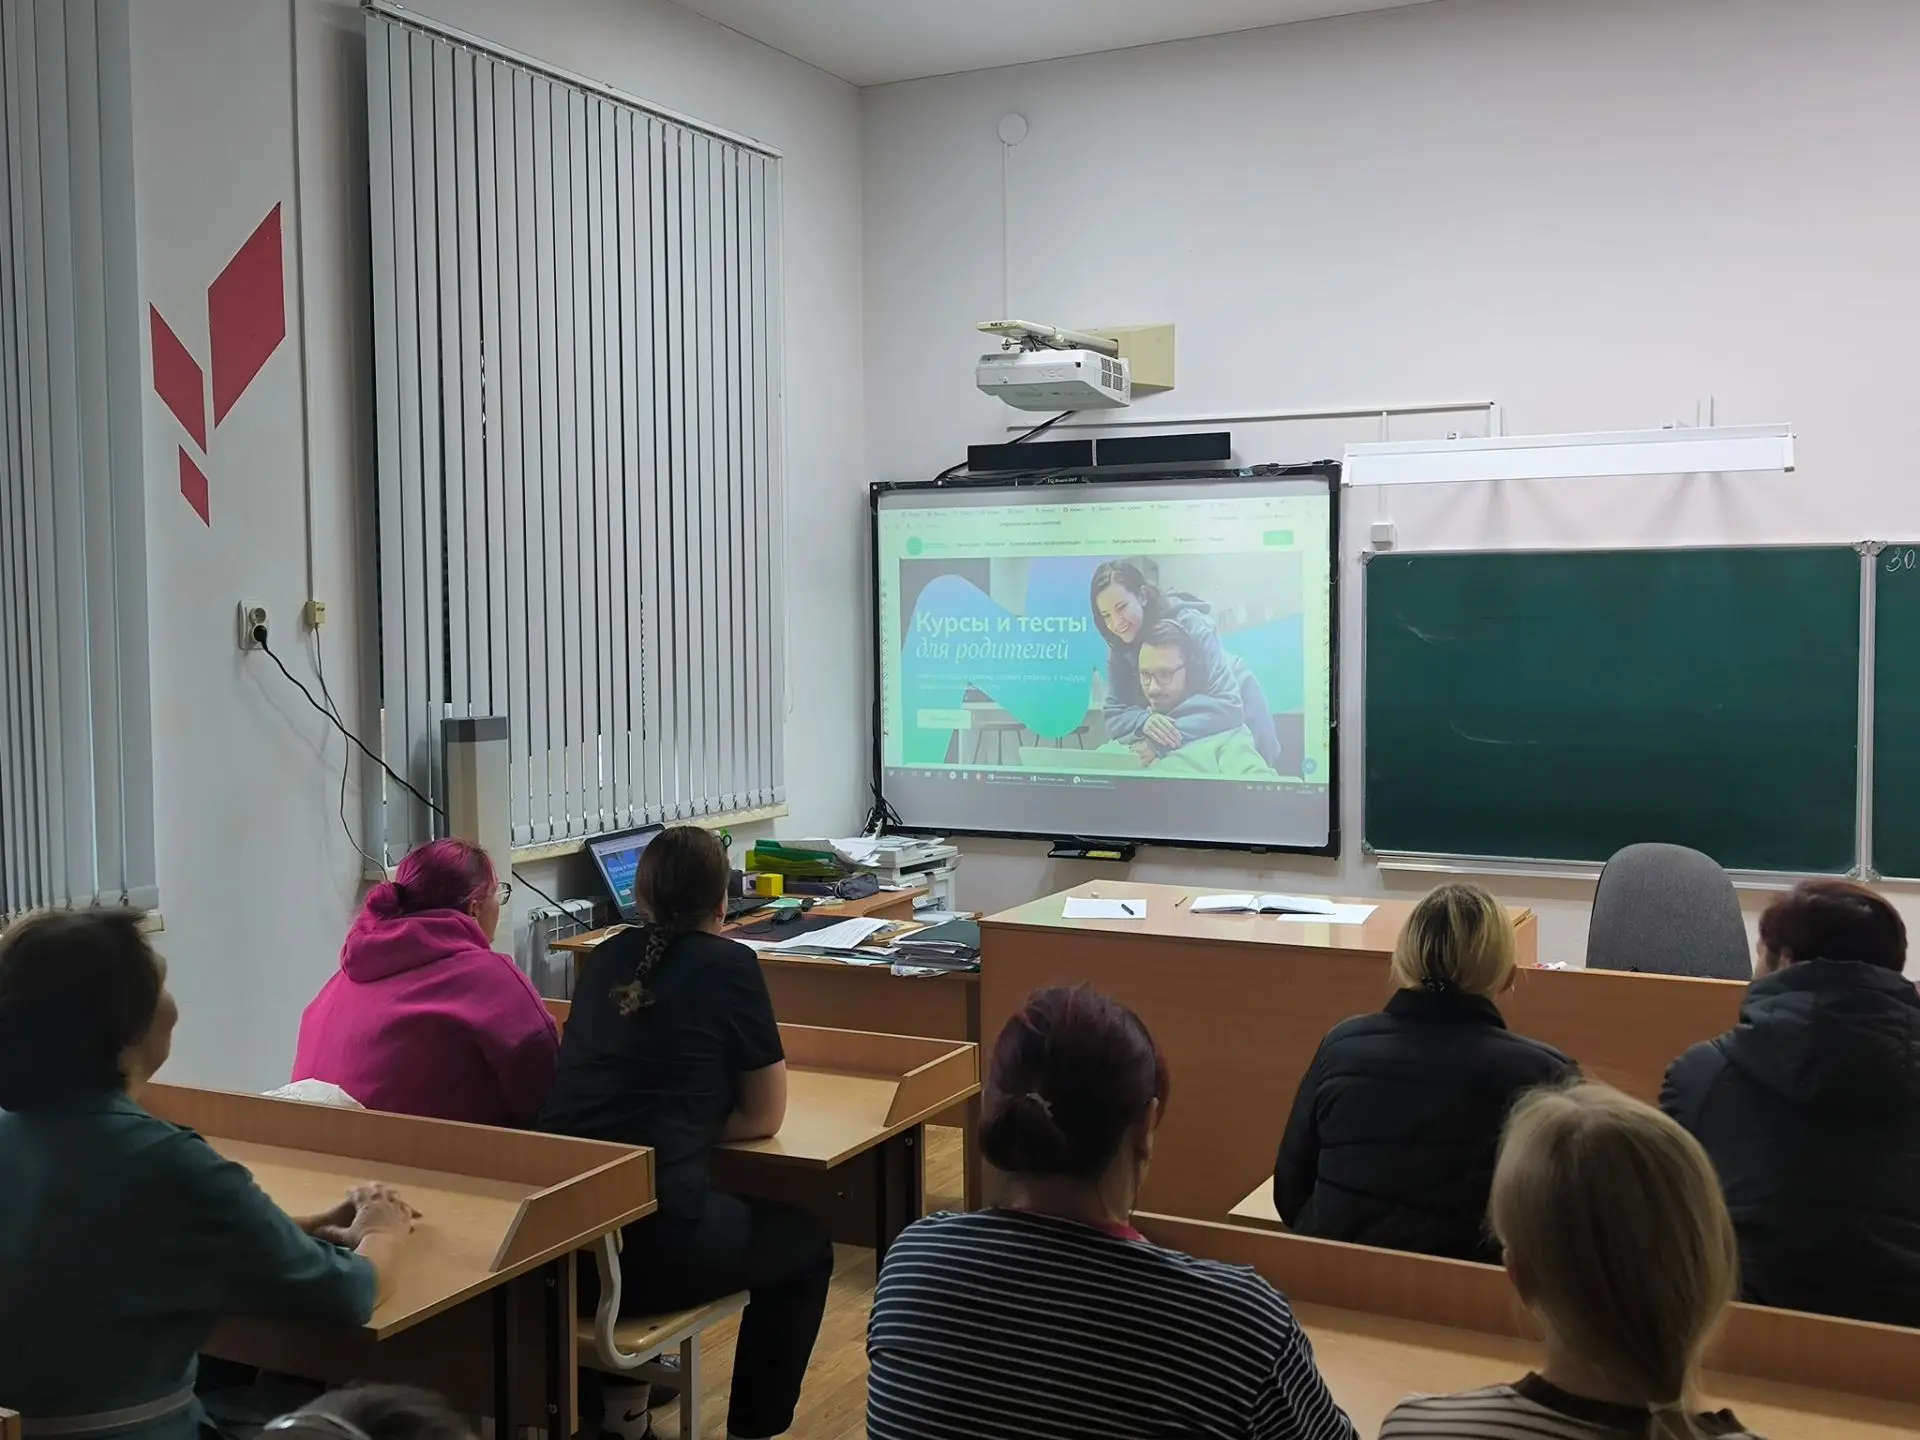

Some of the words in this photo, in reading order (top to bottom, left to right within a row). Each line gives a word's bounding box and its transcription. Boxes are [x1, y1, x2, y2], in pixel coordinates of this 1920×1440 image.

[1037, 367, 1065, 379] NEC
[916, 611, 989, 638] Курсы
[997, 616, 1011, 632] и
[1017, 615, 1087, 633] тесты
[916, 636, 950, 659] для
[956, 636, 1069, 663] родителей
